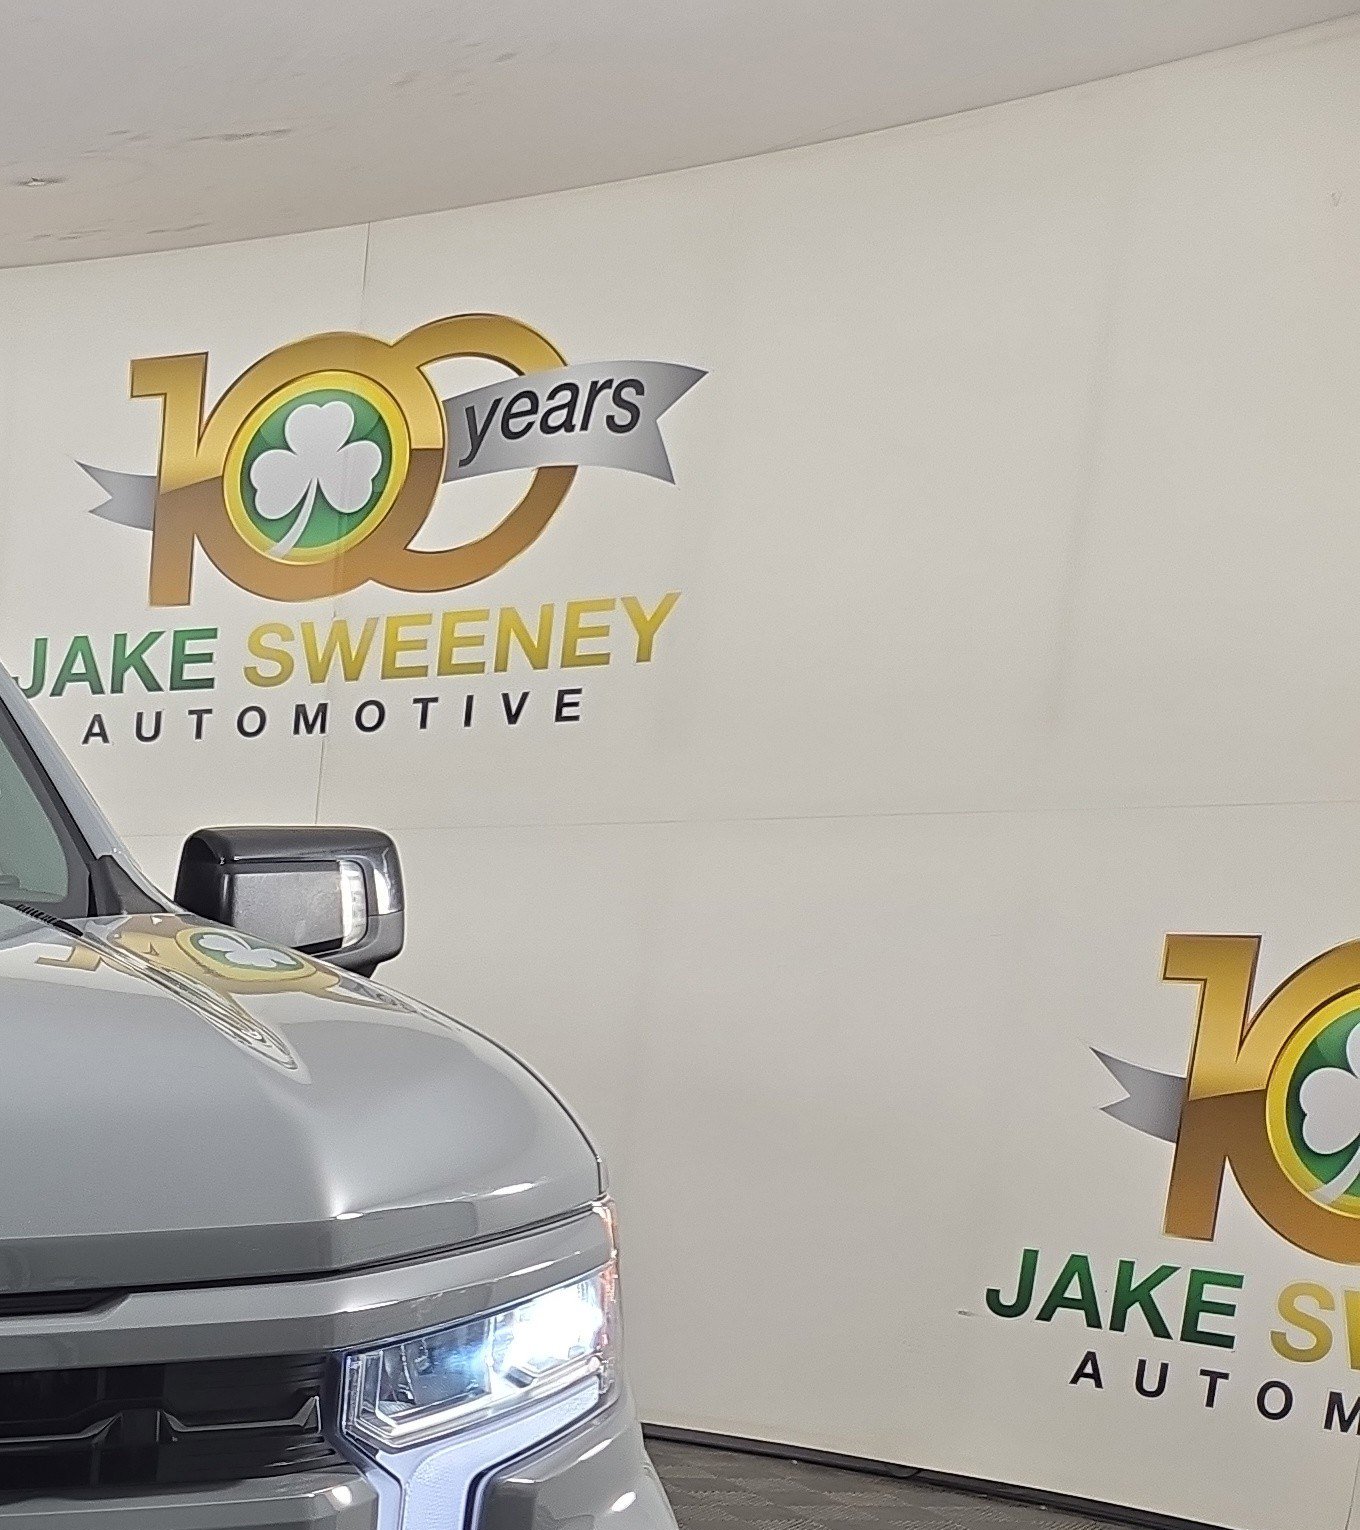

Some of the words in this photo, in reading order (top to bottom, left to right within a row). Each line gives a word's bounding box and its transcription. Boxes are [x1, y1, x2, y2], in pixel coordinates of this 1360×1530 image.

[130, 312, 578, 606] 100
[458, 376, 644, 468] years
[13, 626, 219, 700] JAKE
[243, 591, 682, 689] SWEENEY
[82, 688, 583, 746] AUTOMOTIVE
[985, 1248, 1245, 1350] JAKE
